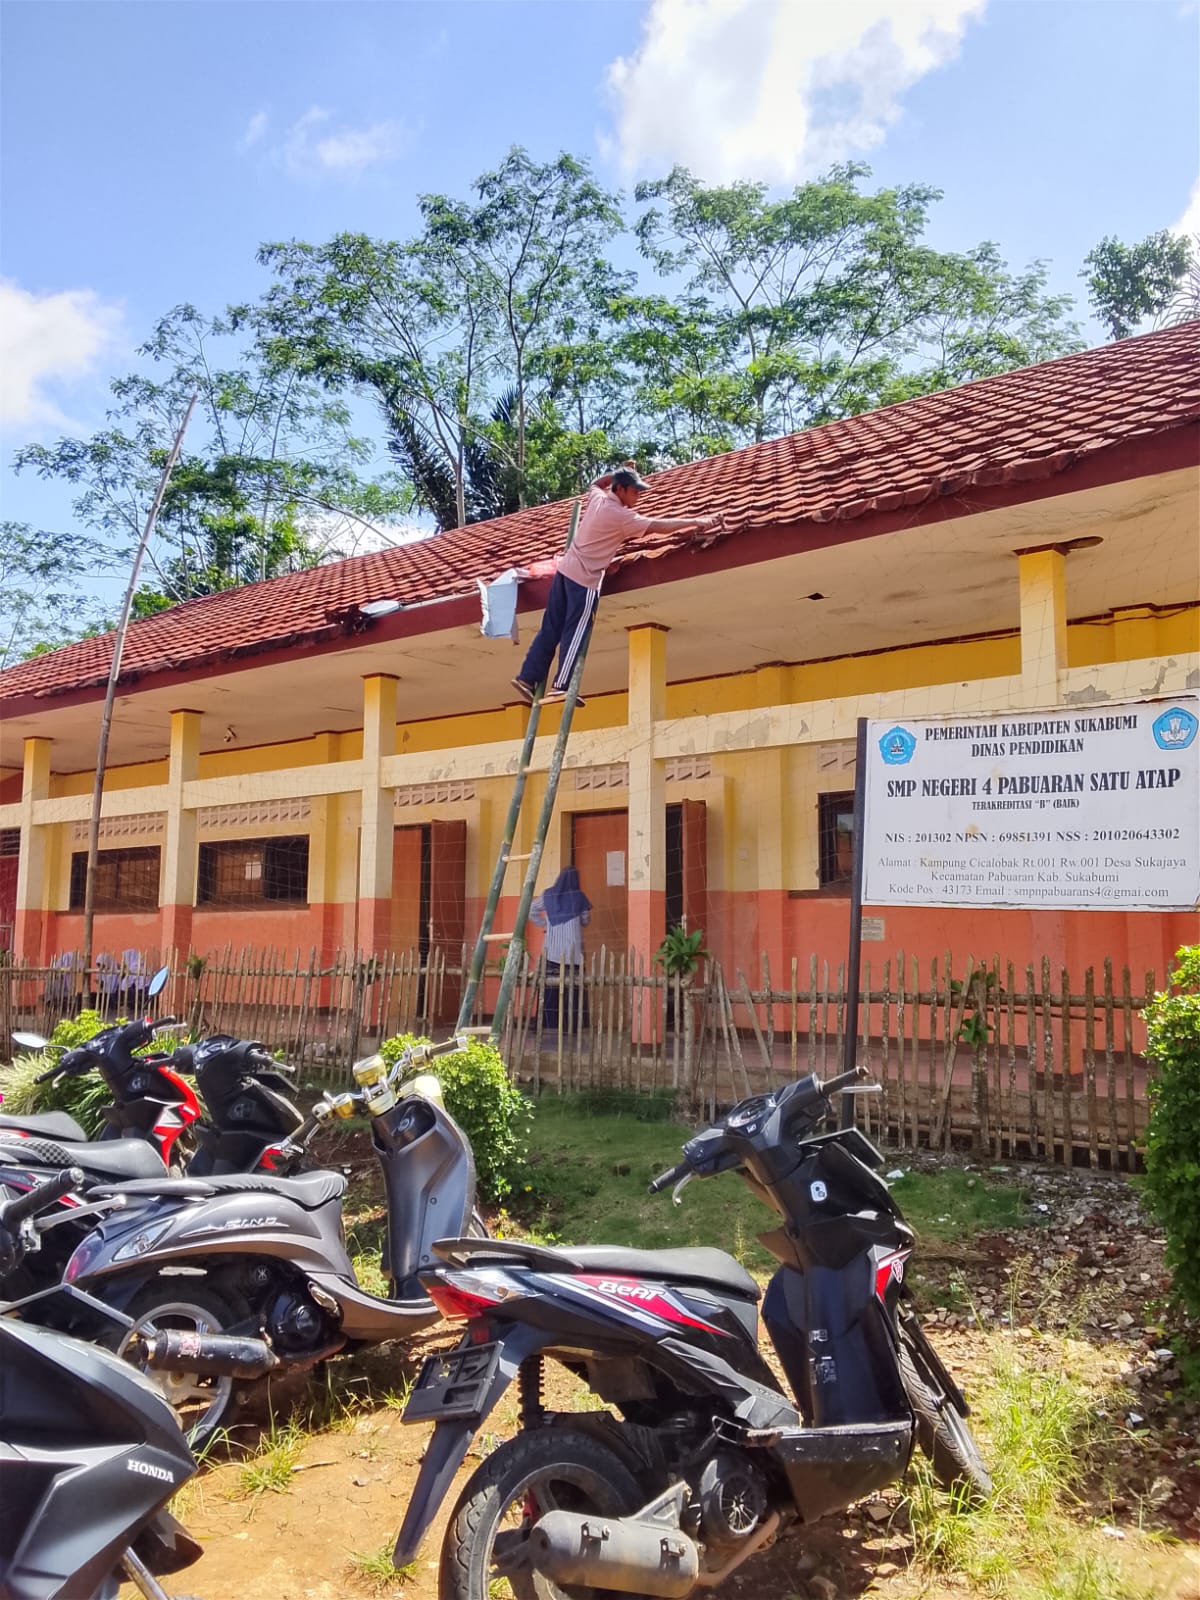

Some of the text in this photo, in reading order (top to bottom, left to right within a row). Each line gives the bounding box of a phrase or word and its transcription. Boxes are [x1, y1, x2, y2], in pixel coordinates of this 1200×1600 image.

[925, 715, 1137, 741] PEMERINTAH KABUPATEN SUKABUMI
[971, 738, 1084, 757] DINAS PENDIDIKAN
[887, 768, 1181, 798] SMP NEGERI 4 PABUARAN SATU ATAP
[972, 800, 1032, 811] TERAKREDITASI
[1053, 799, 1079, 809] (BAIK)
[885, 833, 905, 843] NIS
[915, 833, 952, 843] 201302
[955, 832, 988, 843] NPSN
[999, 832, 1051, 842] 69851391
[1056, 831, 1081, 842] NSS
[1092, 828, 1180, 841] 201020643302
[878, 857, 911, 868] Alamat
[919, 858, 966, 870] Kampung
[969, 857, 1018, 868] Cicalobak
[1104, 857, 1131, 867] Desa
[1135, 856, 1187, 869] Sukajaya
[931, 871, 1119, 882] Kecamatan Pabuaran Kab. Sukabumi
[889, 883, 914, 894] Kode
[916, 884, 933, 894] Pos
[942, 884, 972, 895] 43173
[975, 885, 1004, 896] Email
[127, 1459, 174, 1483] HONDA
